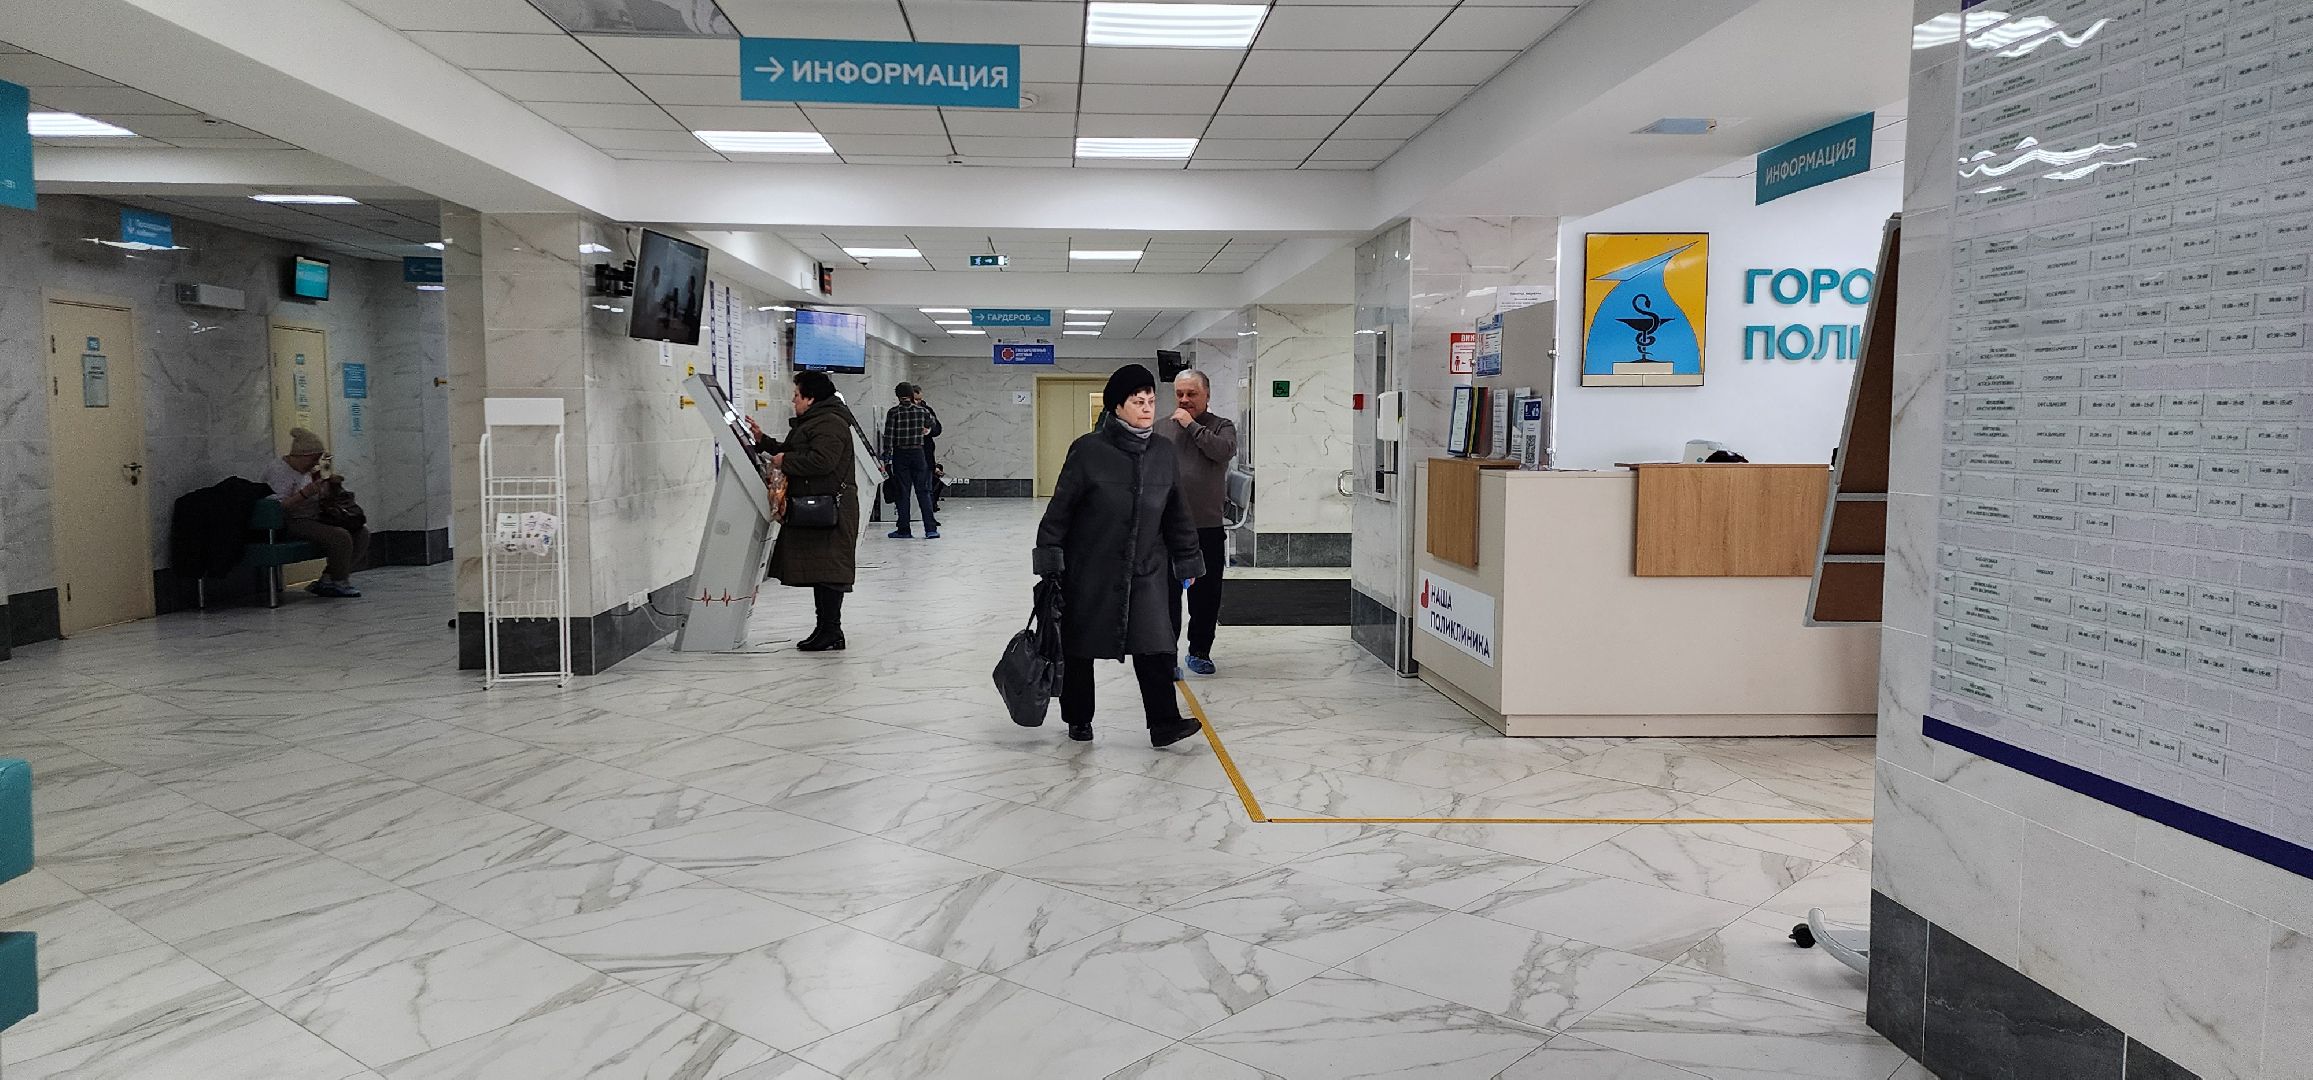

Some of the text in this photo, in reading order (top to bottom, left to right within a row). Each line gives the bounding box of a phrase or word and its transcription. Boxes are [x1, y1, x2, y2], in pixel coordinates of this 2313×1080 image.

[792, 60, 1008, 91] ИНФОРМАЦИЯ
[1765, 137, 1857, 187] ИНФОРМАЦИЯ
[986, 313, 1032, 322] ГАРДЕРОБ
[1430, 584, 1453, 612] НАША
[1430, 610, 1490, 659] ПОЛИКЛИНИКА
